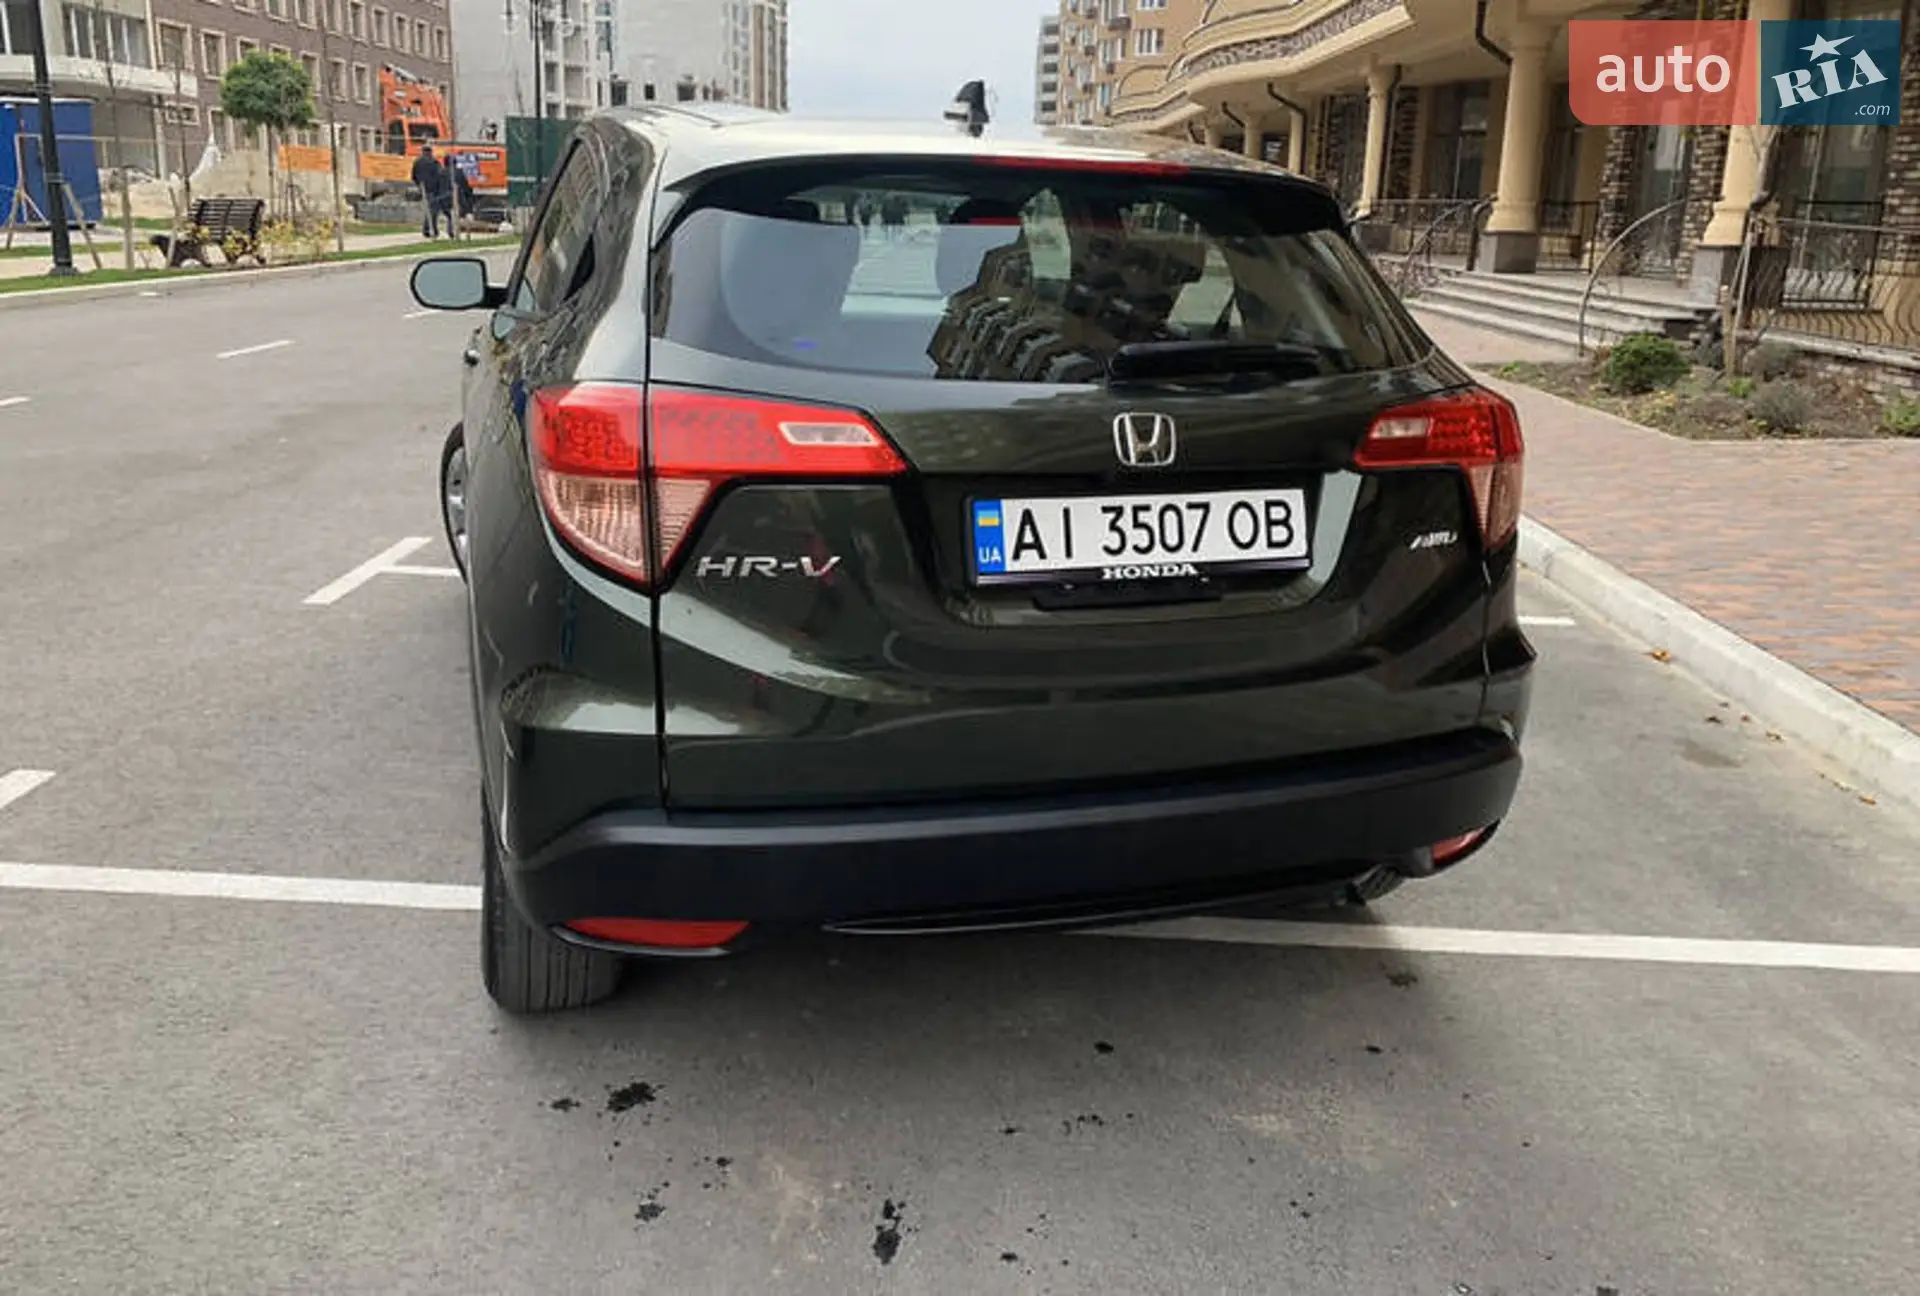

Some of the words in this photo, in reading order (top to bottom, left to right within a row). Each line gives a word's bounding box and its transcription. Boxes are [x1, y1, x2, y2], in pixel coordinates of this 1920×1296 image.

[1012, 506, 1073, 561] AI
[1101, 501, 1210, 556] 3507
[1227, 499, 1294, 550] OB
[978, 547, 1001, 564] UA
[696, 555, 841, 577] HR-V
[1101, 562, 1198, 580] HONDA
